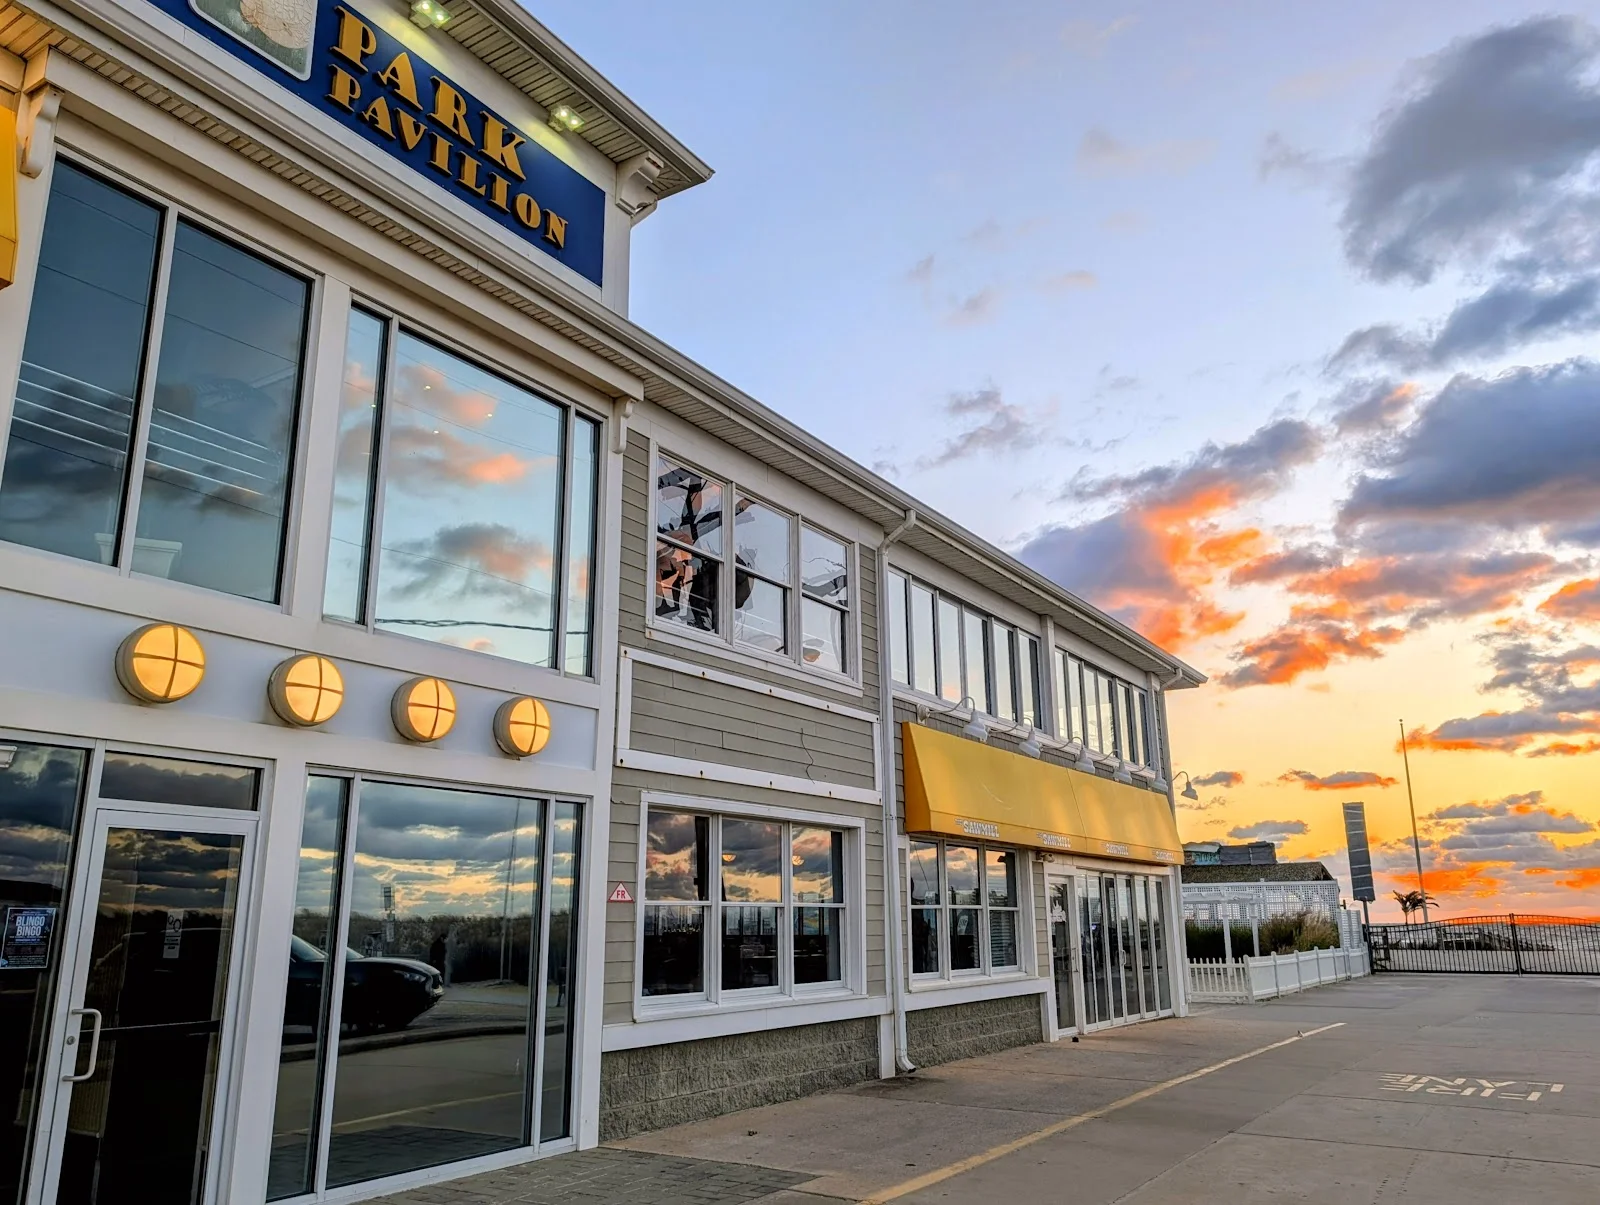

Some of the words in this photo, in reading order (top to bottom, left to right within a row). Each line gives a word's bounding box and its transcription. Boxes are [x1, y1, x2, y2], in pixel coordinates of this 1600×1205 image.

[330, 5, 527, 181] PARK
[325, 64, 569, 249] PAVILION
[963, 820, 1000, 838] SAWMILL
[616, 890, 626, 899] FR
[16, 916, 45, 926] BLINGO
[16, 926, 41, 936] BINGO
[1378, 1073, 1564, 1093] LANE
[1378, 1081, 1542, 1101] FIRE
